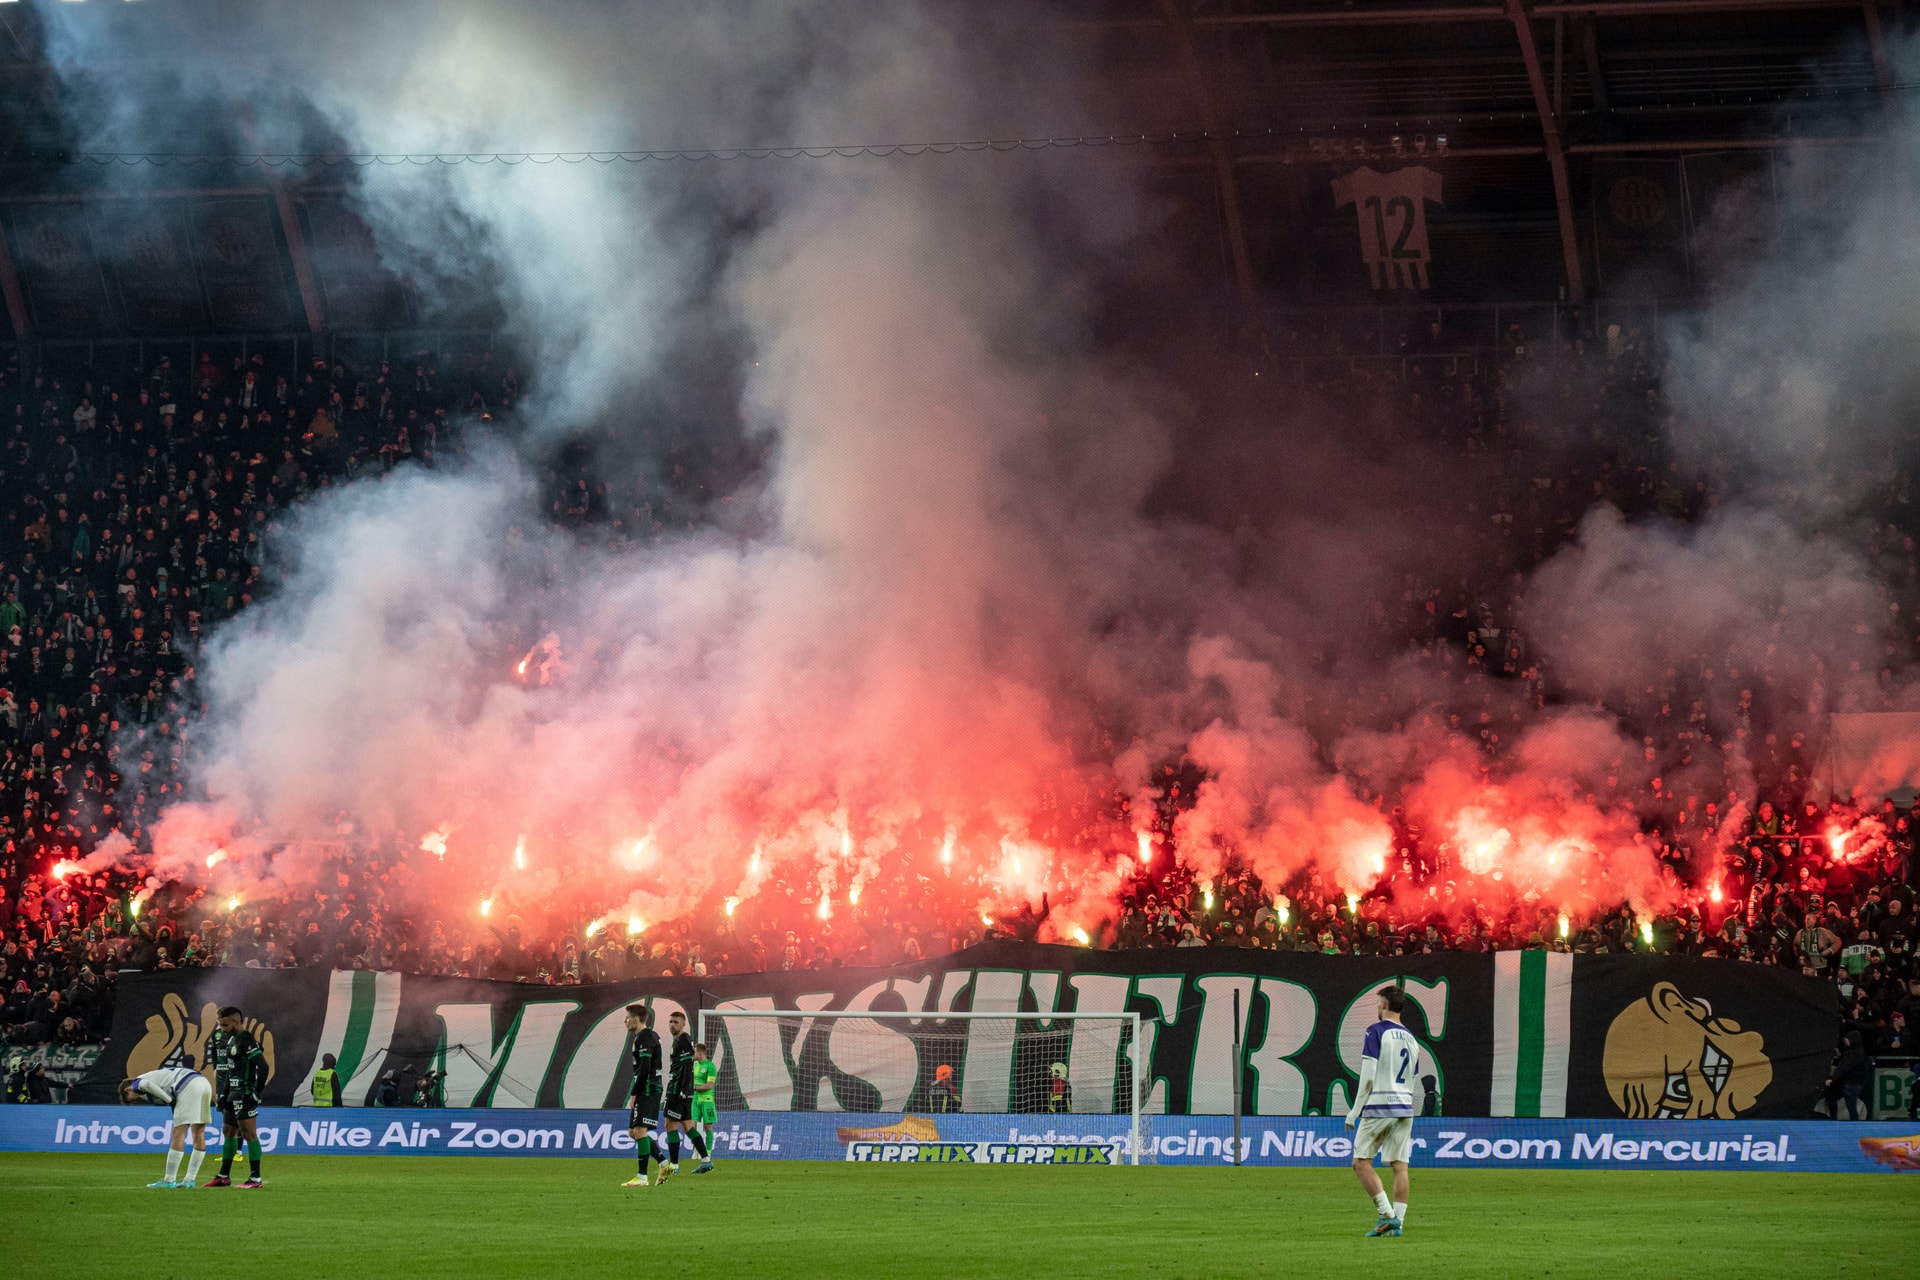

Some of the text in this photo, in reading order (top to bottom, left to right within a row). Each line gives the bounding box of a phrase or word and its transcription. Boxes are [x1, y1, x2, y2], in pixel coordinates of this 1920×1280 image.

[1364, 195, 1421, 258] 12
[425, 968, 1450, 1117] MONSTERS
[1395, 1047, 1411, 1084] 2
[287, 1121, 371, 1147] Nike
[379, 1122, 440, 1147] Air
[448, 1123, 562, 1149] Zoom
[1259, 1130, 1353, 1158] Nike
[1435, 1131, 1561, 1160] Zoom
[1571, 1133, 1797, 1162] Mercurial.
